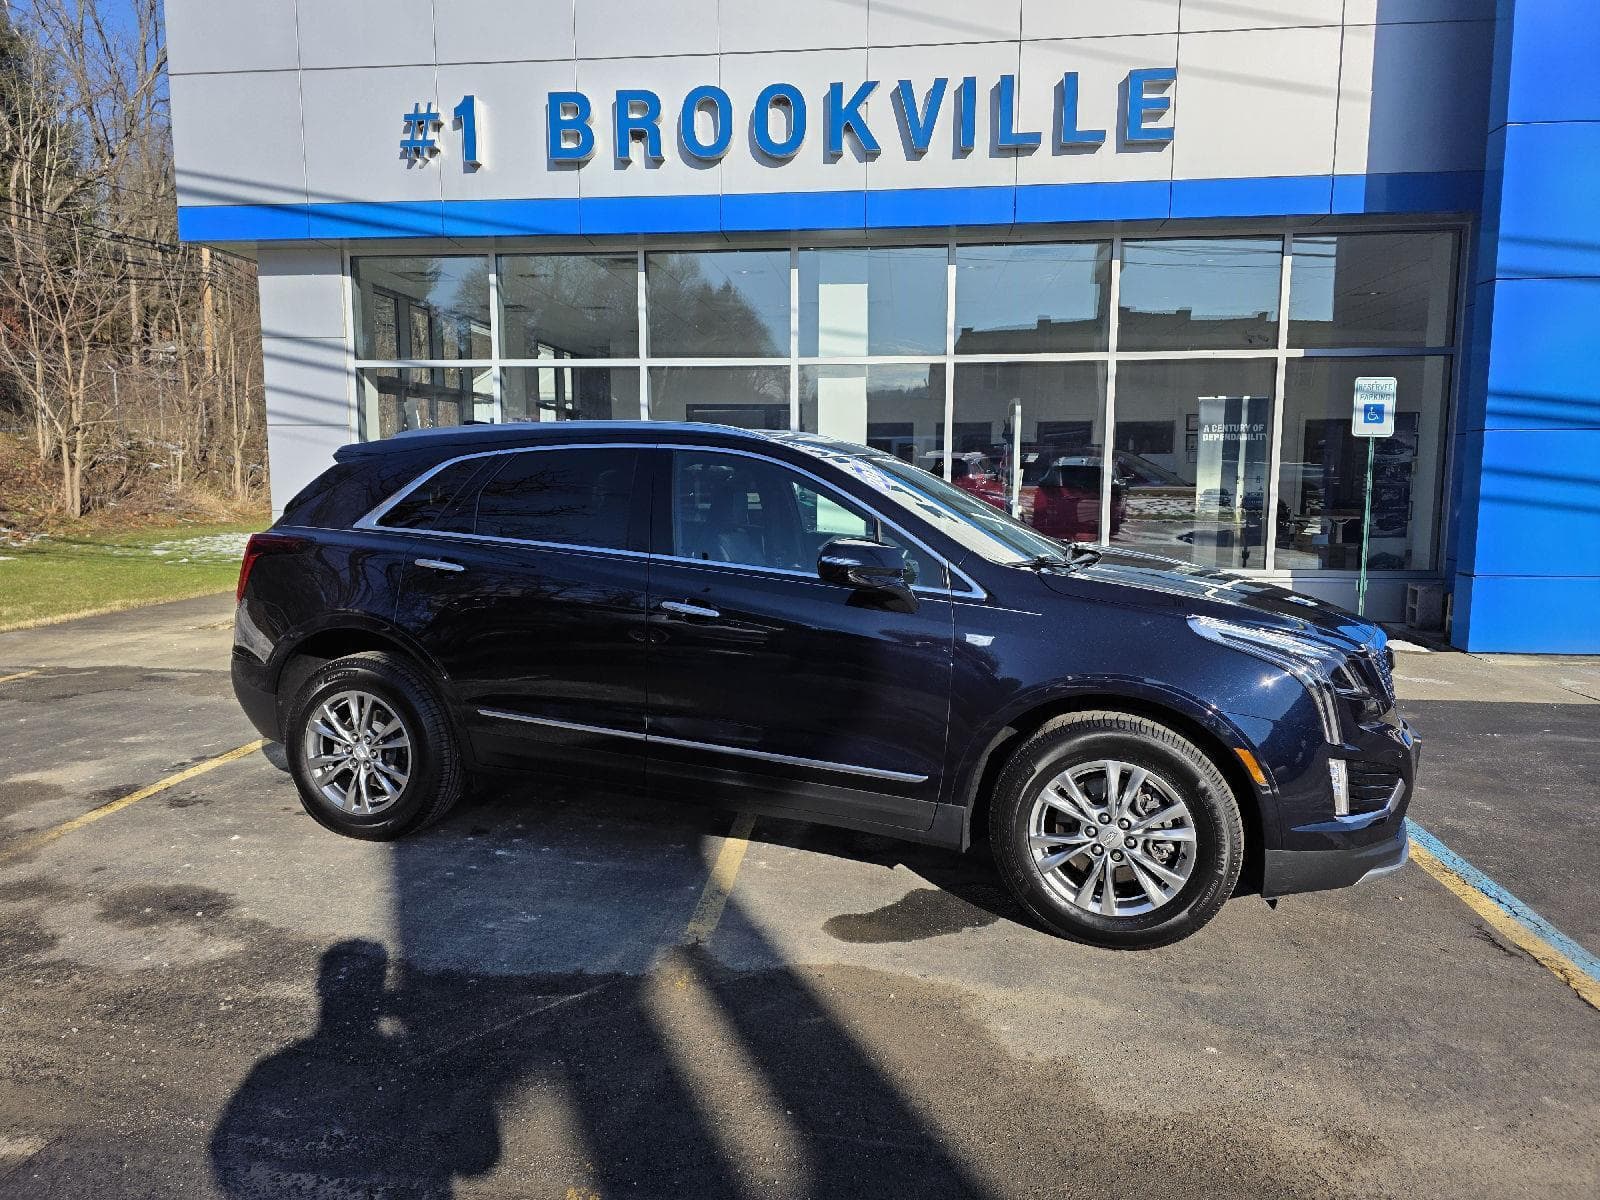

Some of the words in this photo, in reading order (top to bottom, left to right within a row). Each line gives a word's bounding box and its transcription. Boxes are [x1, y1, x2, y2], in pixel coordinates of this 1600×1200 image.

[400, 94, 478, 162] #1
[547, 68, 1177, 162] BROOKVILLE
[1358, 383, 1393, 391] RESERVED
[1360, 393, 1392, 401] PARKING
[1203, 424, 1210, 432] A
[1211, 424, 1250, 432] CENTURY
[1252, 424, 1265, 432] OF
[1202, 433, 1268, 441] DEPENDABILITY
